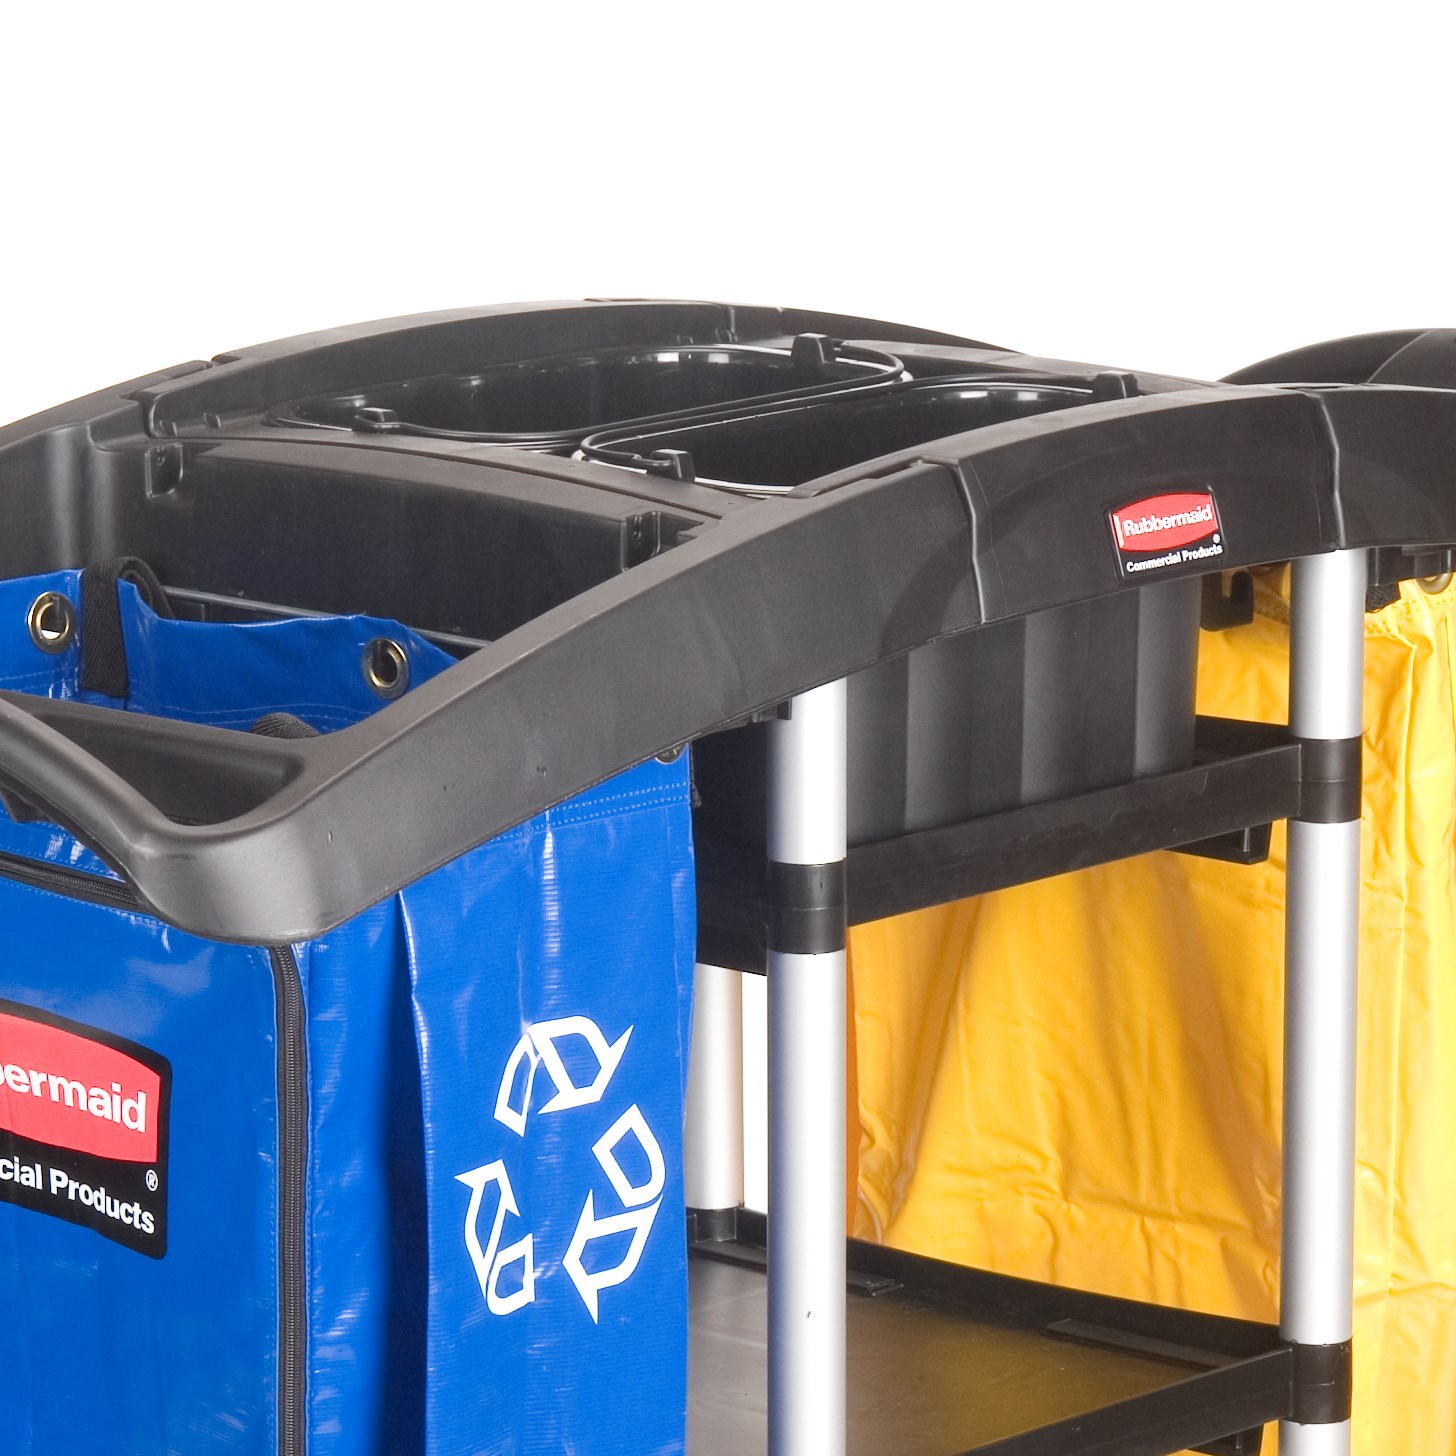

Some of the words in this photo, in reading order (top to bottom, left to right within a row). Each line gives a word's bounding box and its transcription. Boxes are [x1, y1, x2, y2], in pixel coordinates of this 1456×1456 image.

[1123, 505, 1212, 536] Rubbermaid
[1126, 552, 1181, 572] Commercial
[1183, 545, 1223, 562] Products
[49, 1167, 155, 1234] Products
